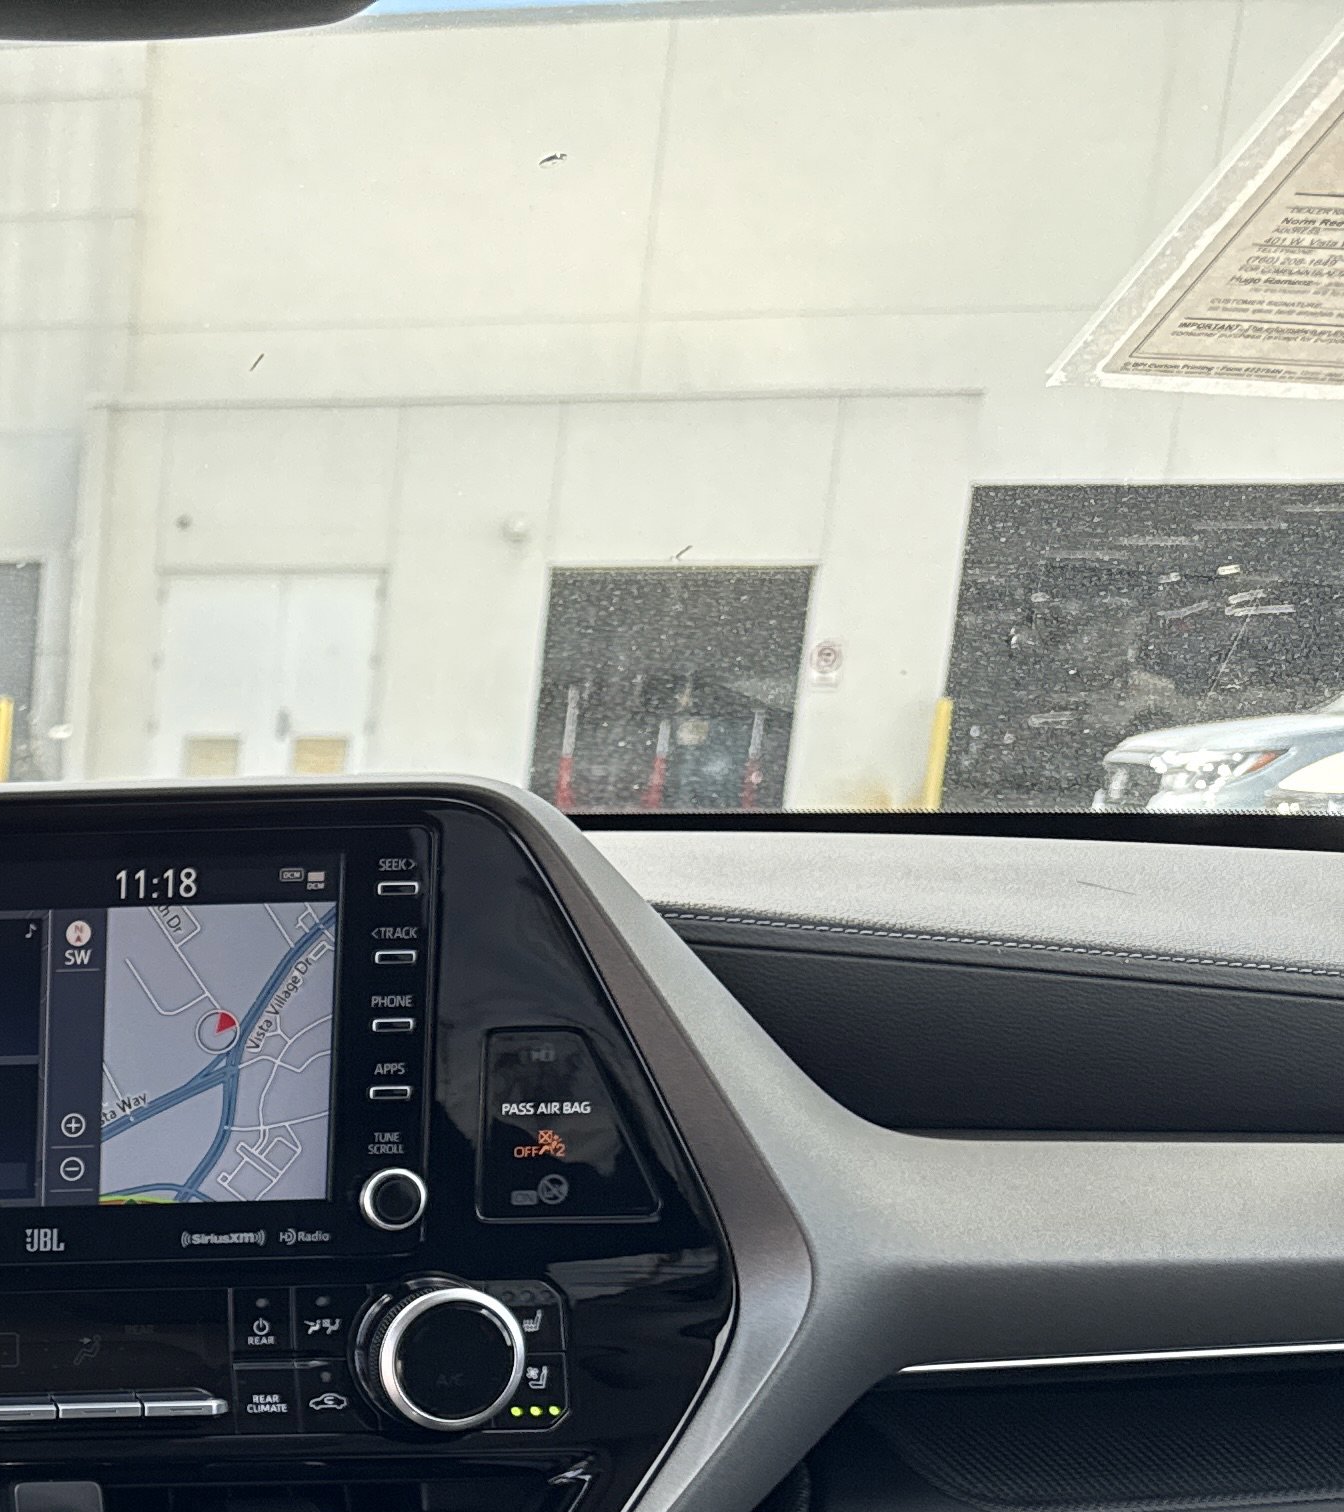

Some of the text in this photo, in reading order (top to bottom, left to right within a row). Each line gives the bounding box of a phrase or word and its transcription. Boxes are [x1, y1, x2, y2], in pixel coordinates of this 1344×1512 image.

[115, 867, 198, 900] 11:18
[64, 949, 93, 966] SW
[245, 956, 313, 1052] Vista Village Dr
[371, 995, 412, 1008] PHONE
[374, 1063, 405, 1075] APPS
[116, 1092, 148, 1114] Way
[502, 1101, 592, 1116] PASS AIR BAG
[374, 1132, 401, 1143] TUNE
[368, 1143, 404, 1155] SCROLL
[514, 1146, 539, 1158] OFF
[26, 1228, 65, 1253] JBL
[297, 1230, 330, 1243] Radio
[247, 1335, 275, 1345] REAR
[252, 1394, 280, 1404] REAR
[246, 1403, 288, 1414] CLIMATE
